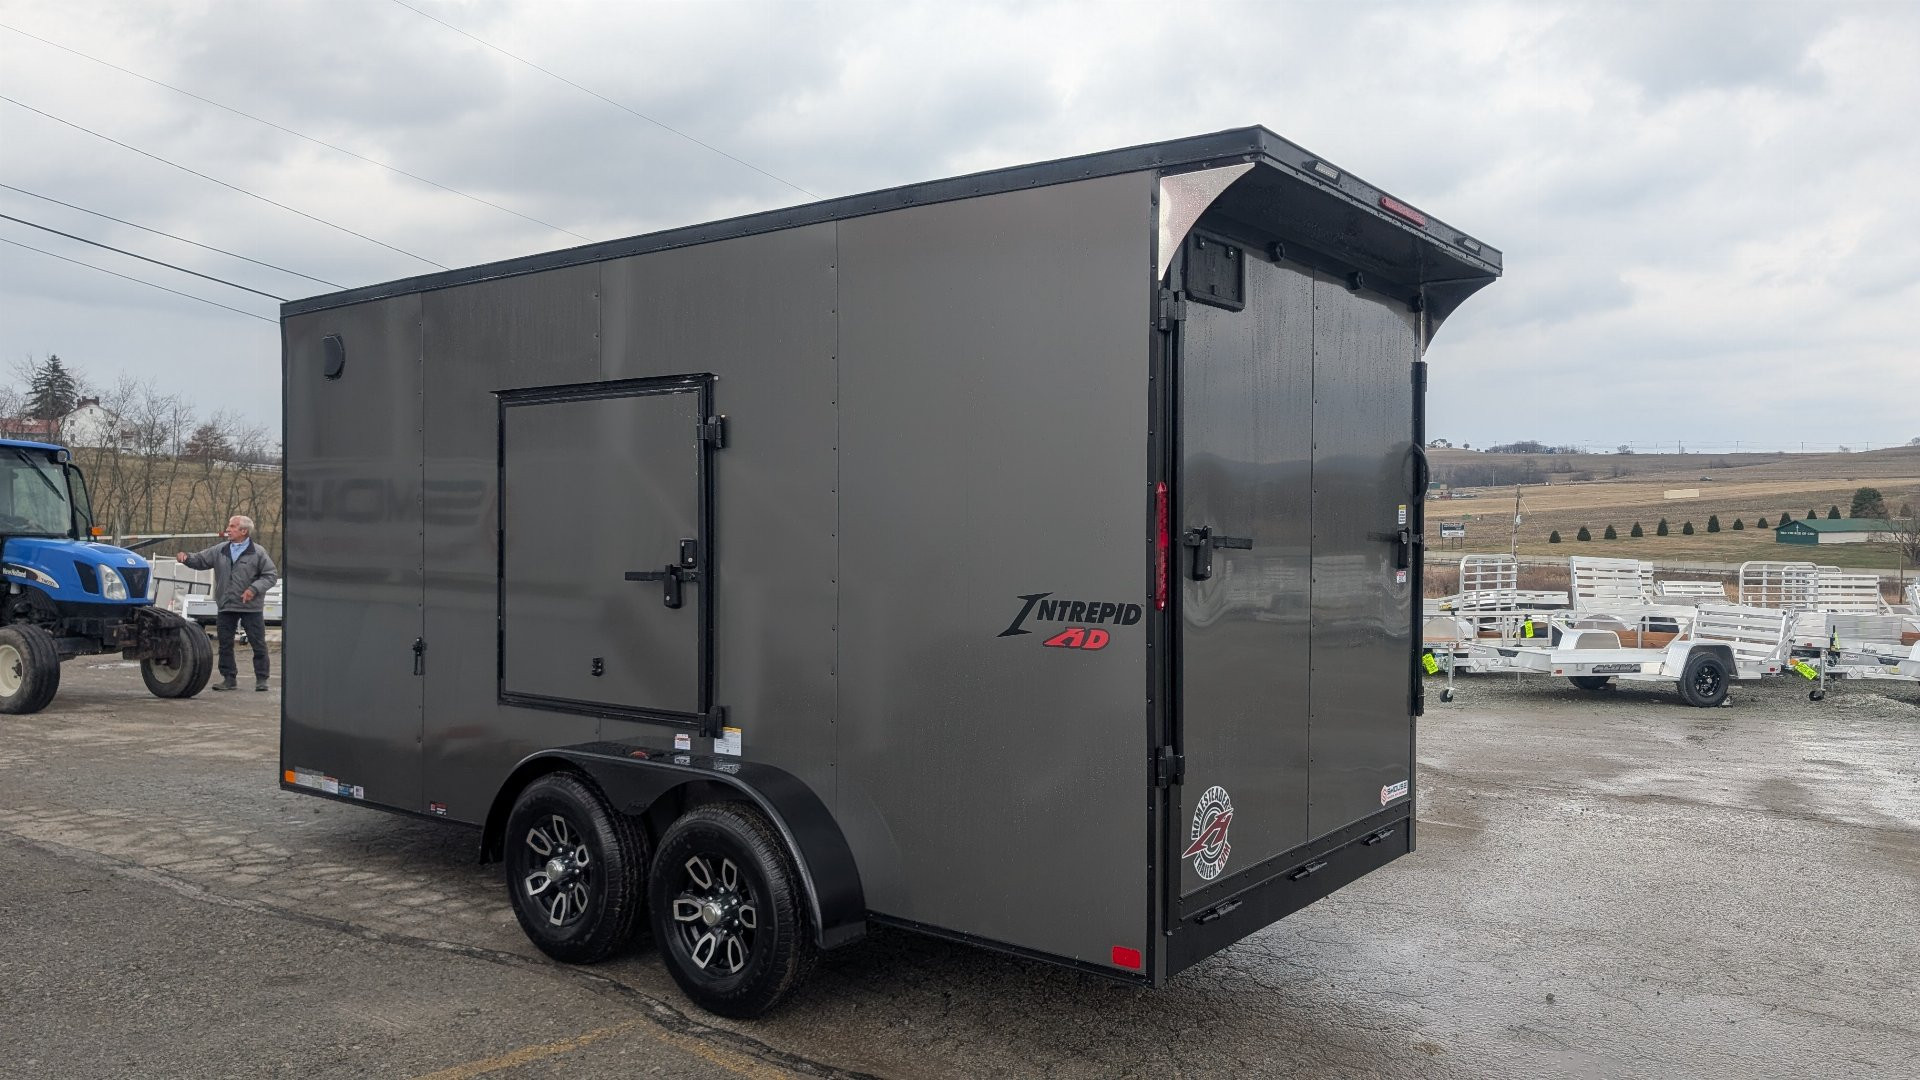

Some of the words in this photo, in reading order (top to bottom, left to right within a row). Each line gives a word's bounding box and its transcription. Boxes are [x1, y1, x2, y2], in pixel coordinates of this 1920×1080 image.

[996, 592, 1143, 637] INTREPID
[1042, 626, 1110, 650] AD
[1191, 787, 1232, 839] HOMESTEADER
